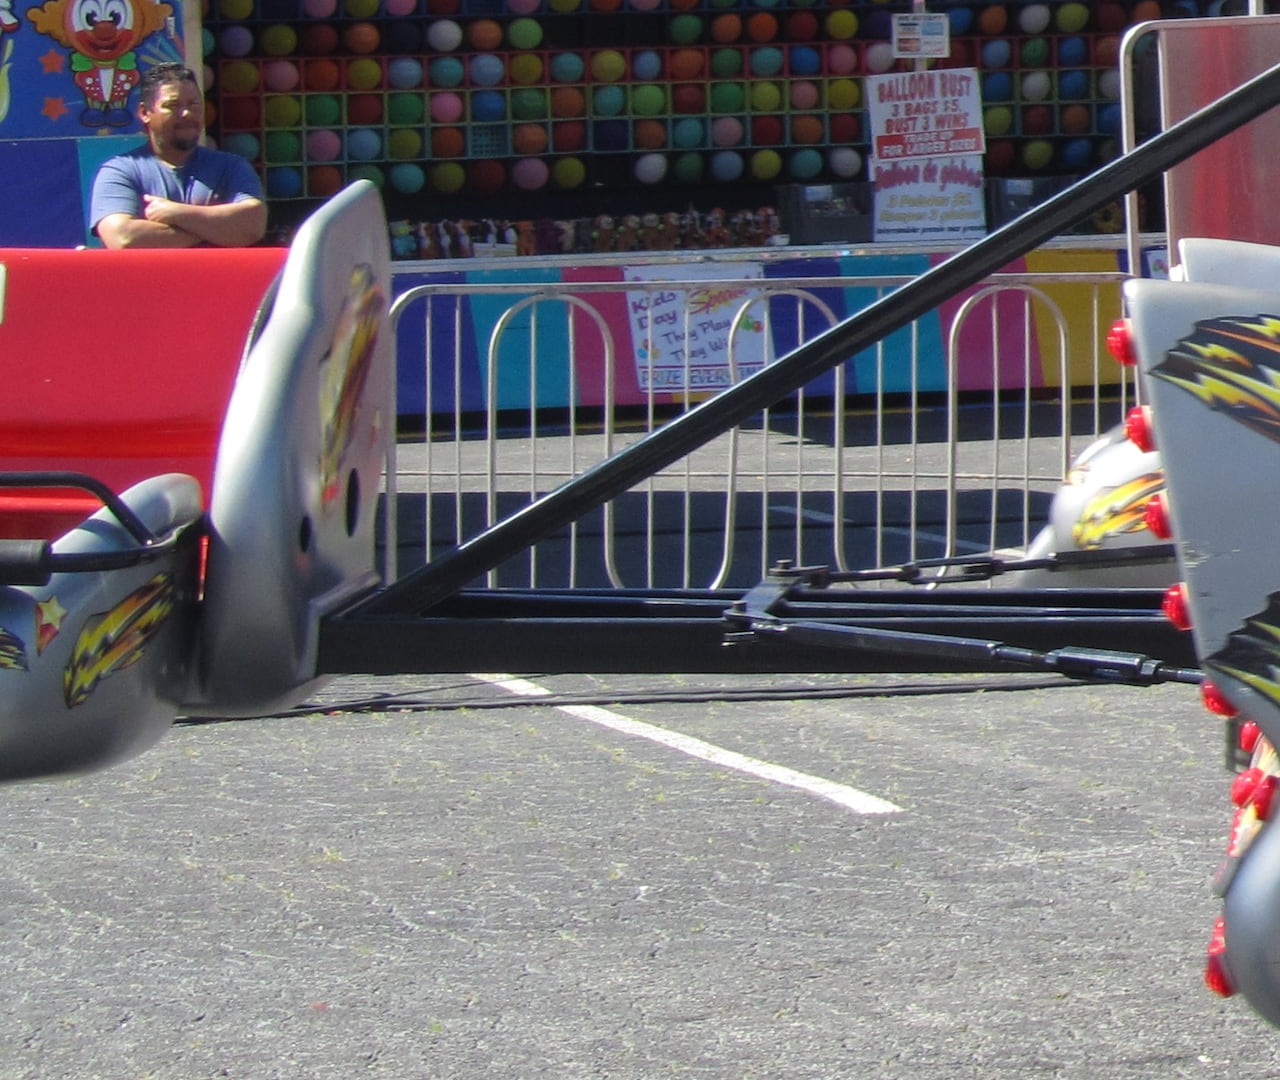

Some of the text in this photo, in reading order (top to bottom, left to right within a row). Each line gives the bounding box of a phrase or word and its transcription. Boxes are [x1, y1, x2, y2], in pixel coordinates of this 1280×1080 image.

[878, 72, 972, 103] BALLOON BUST
[891, 104, 899, 117] 3
[905, 100, 938, 116] BAGS
[885, 112, 968, 134] BUST 3 WINS
